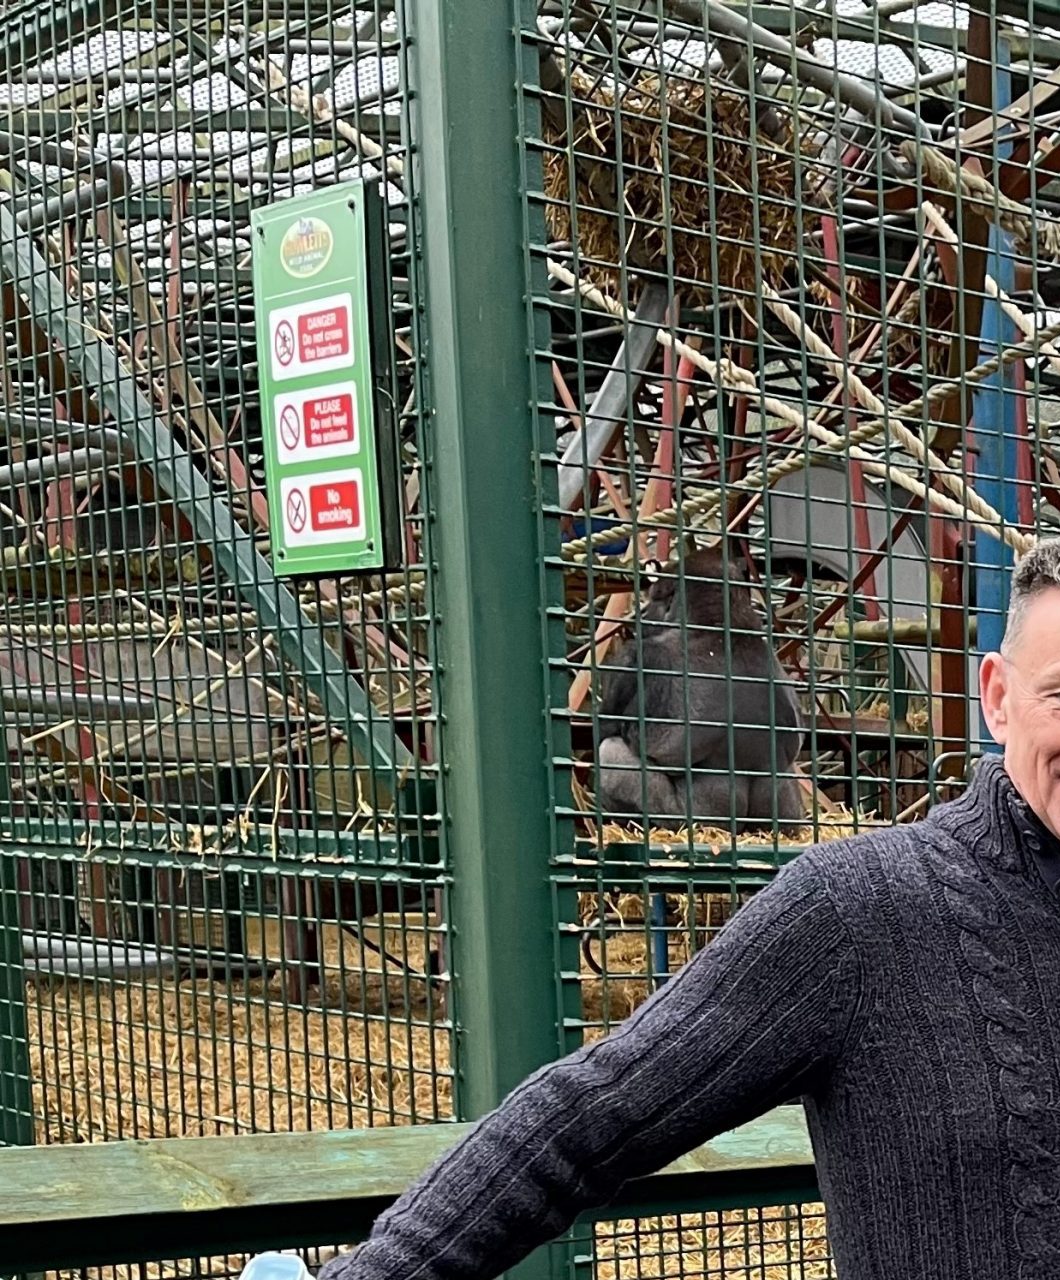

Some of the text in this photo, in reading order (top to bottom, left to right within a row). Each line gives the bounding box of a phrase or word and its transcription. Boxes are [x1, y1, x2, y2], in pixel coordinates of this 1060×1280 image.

[307, 312, 337, 330] DANGER
[302, 333, 312, 346] Do
[312, 330, 324, 344] not
[304, 342, 343, 360] the barriers
[314, 398, 342, 415] PLEASE
[310, 417, 320, 431] Do
[320, 415, 332, 429] not
[326, 488, 341, 505] No
[317, 506, 353, 525] smoking
